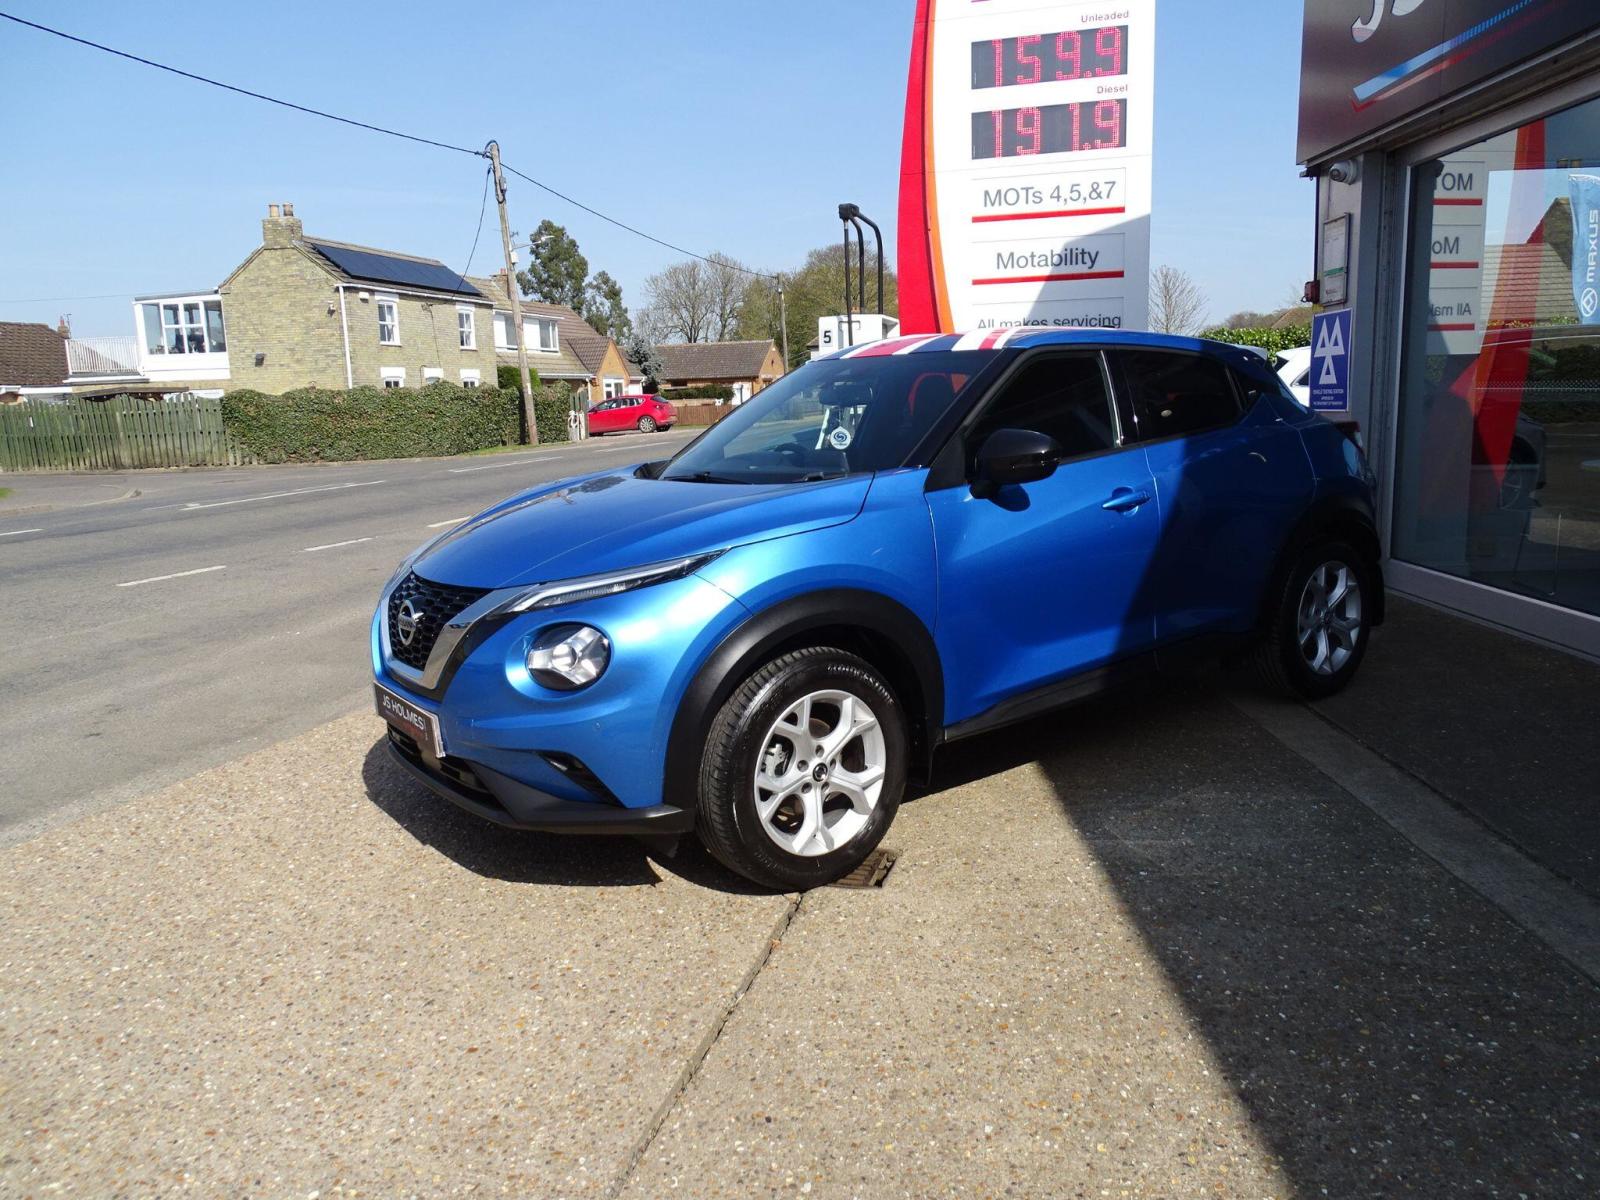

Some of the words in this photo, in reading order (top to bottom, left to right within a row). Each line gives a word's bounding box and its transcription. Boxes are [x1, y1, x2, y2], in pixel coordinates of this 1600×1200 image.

[1081, 10, 1129, 23] Unleaded
[992, 26, 1121, 87] 159.9
[1097, 84, 1128, 94] Diesel
[991, 99, 1120, 158] 191.9
[983, 186, 1043, 208] MOTs
[1050, 181, 1116, 205] 4,5,&7
[996, 247, 1099, 269] Motability
[978, 319, 995, 329] All
[1000, 317, 1048, 327] makes
[1053, 314, 1121, 329] servicing
[823, 330, 832, 344] 5
[382, 694, 391, 709] JS
[391, 700, 424, 730] HOLMES
